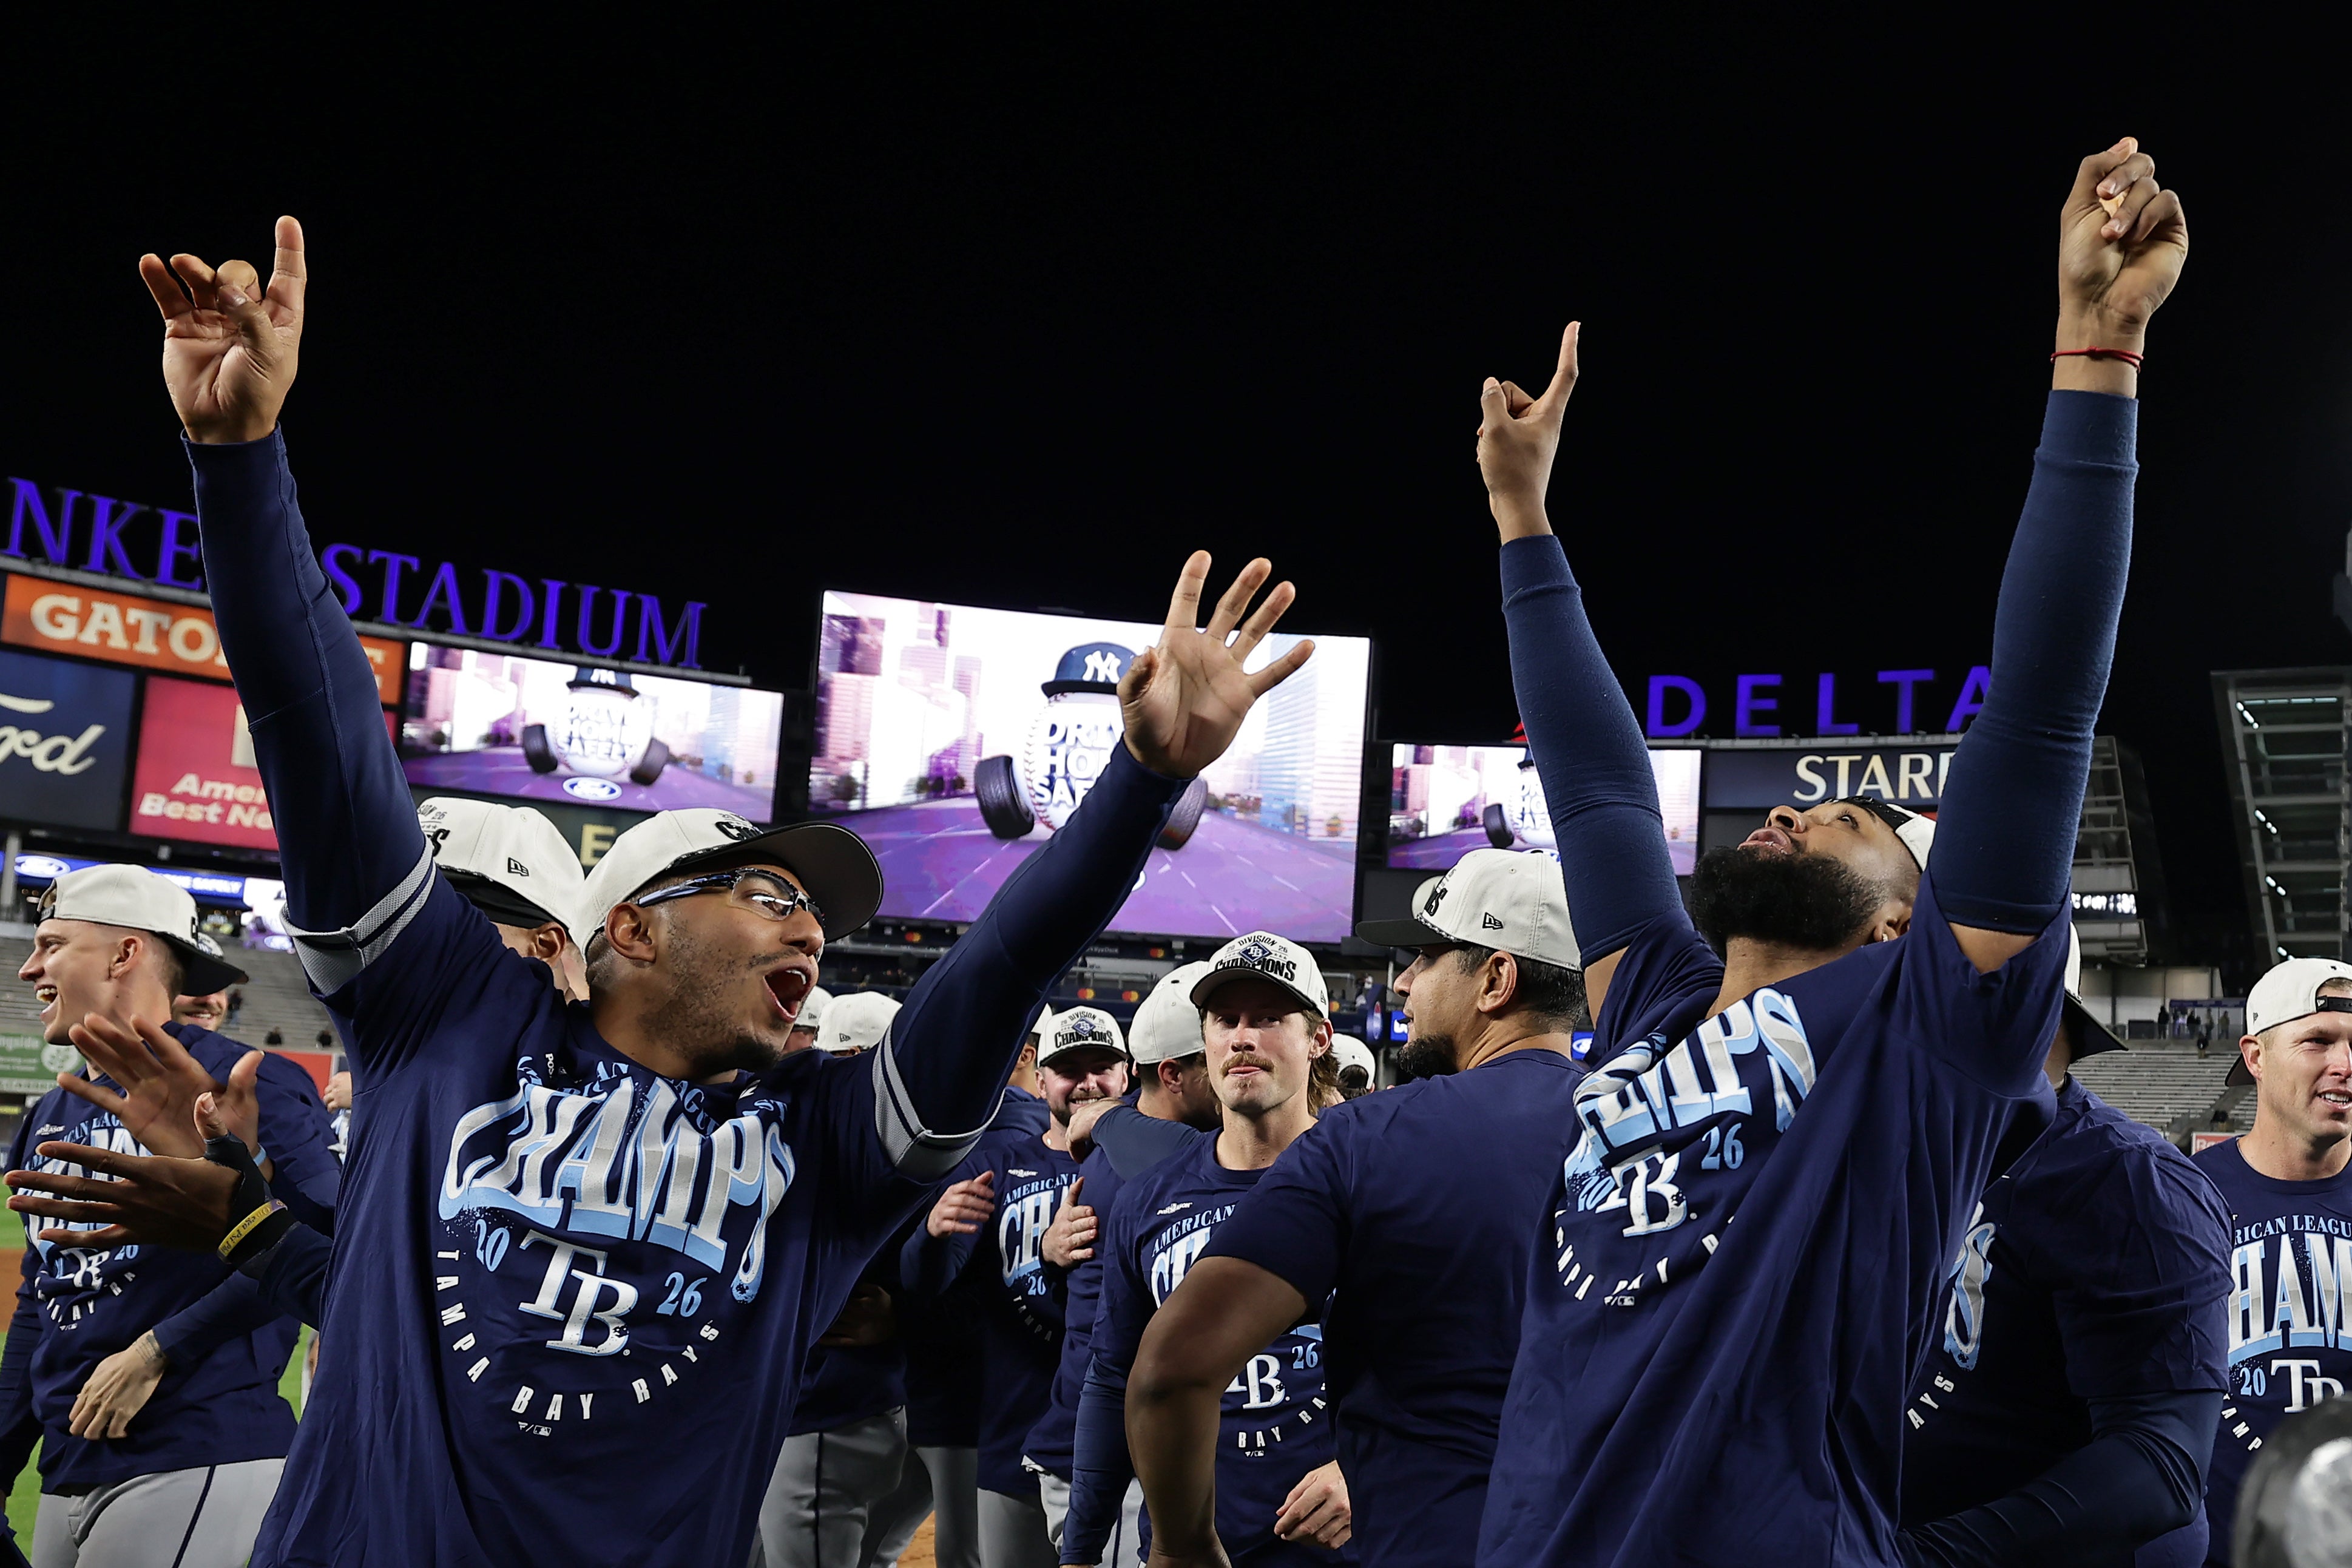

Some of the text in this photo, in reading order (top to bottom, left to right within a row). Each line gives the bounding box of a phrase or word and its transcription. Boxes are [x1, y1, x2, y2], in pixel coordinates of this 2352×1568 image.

[320, 542, 709, 668] STADIUM
[1646, 665, 1993, 738] DELTA
[1043, 718, 1123, 748] DRIV
[138, 791, 224, 825] Best
[1032, 776, 1094, 809] SAF
[1238, 934, 1277, 947] DIVISION
[1068, 1010, 1097, 1021] DIVISION
[1701, 1123, 1745, 1171] 26
[438, 1075, 796, 1304] CHAMPS
[1003, 1174, 1069, 1206] AMERICAN
[1151, 1204, 1236, 1258] AMERICAN
[474, 1218, 708, 1357] 20 TB 26
[436, 1249, 719, 1421] TAMPA BAY RAYS
[1291, 1342, 1319, 1370] 26
[2240, 1367, 2266, 1397] 20
[1238, 1426, 1282, 1448] BAY
